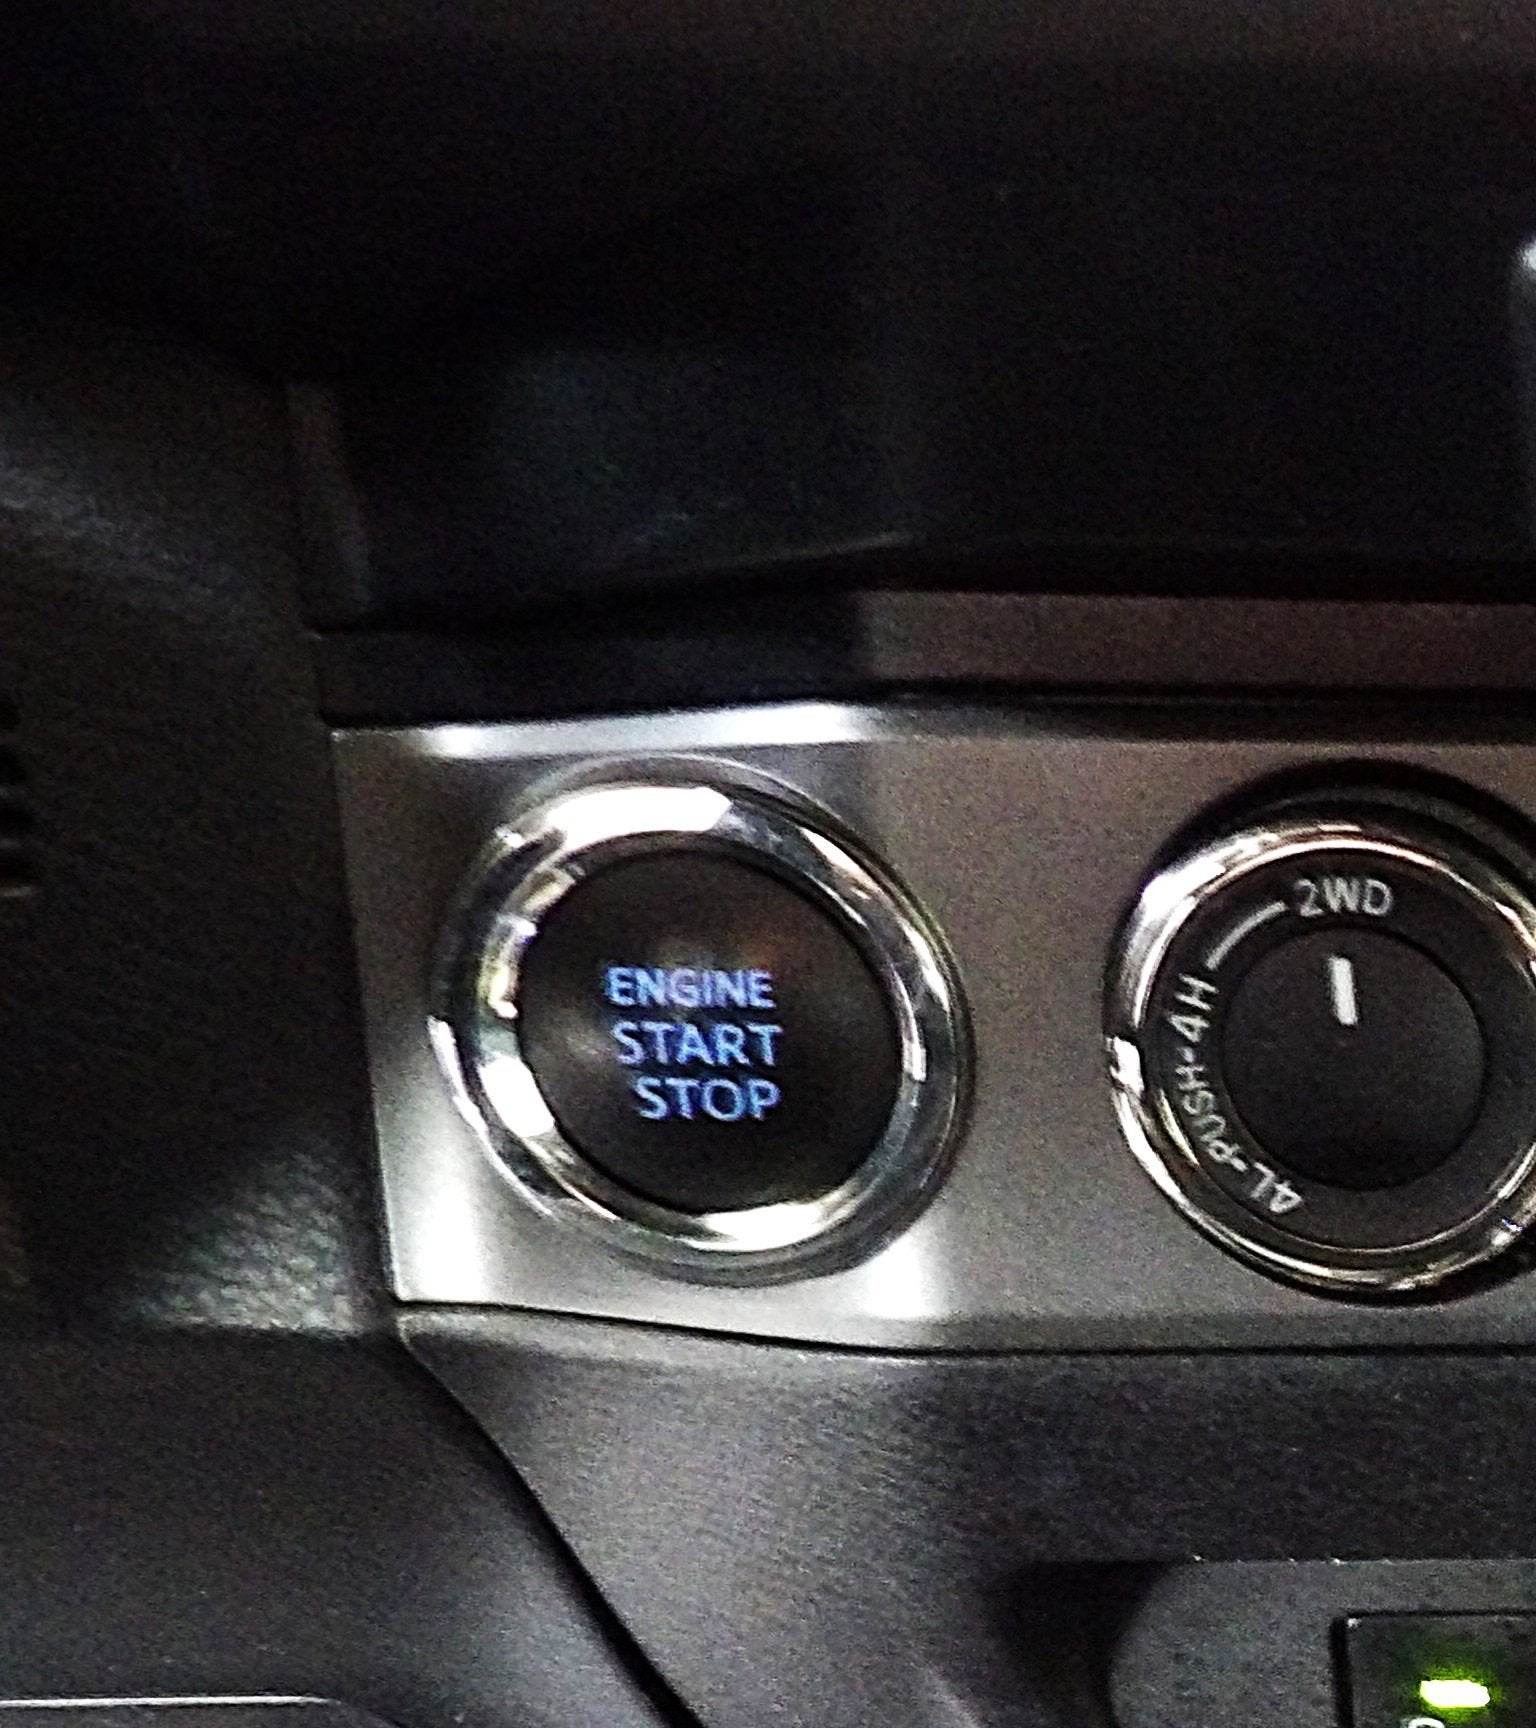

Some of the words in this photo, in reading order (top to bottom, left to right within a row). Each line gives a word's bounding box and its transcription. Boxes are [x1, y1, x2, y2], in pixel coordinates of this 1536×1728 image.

[1293, 877, 1393, 917] 2WD
[606, 966, 776, 1009] ENGINE
[611, 1022, 782, 1066] START
[634, 1077, 781, 1121] STOP
